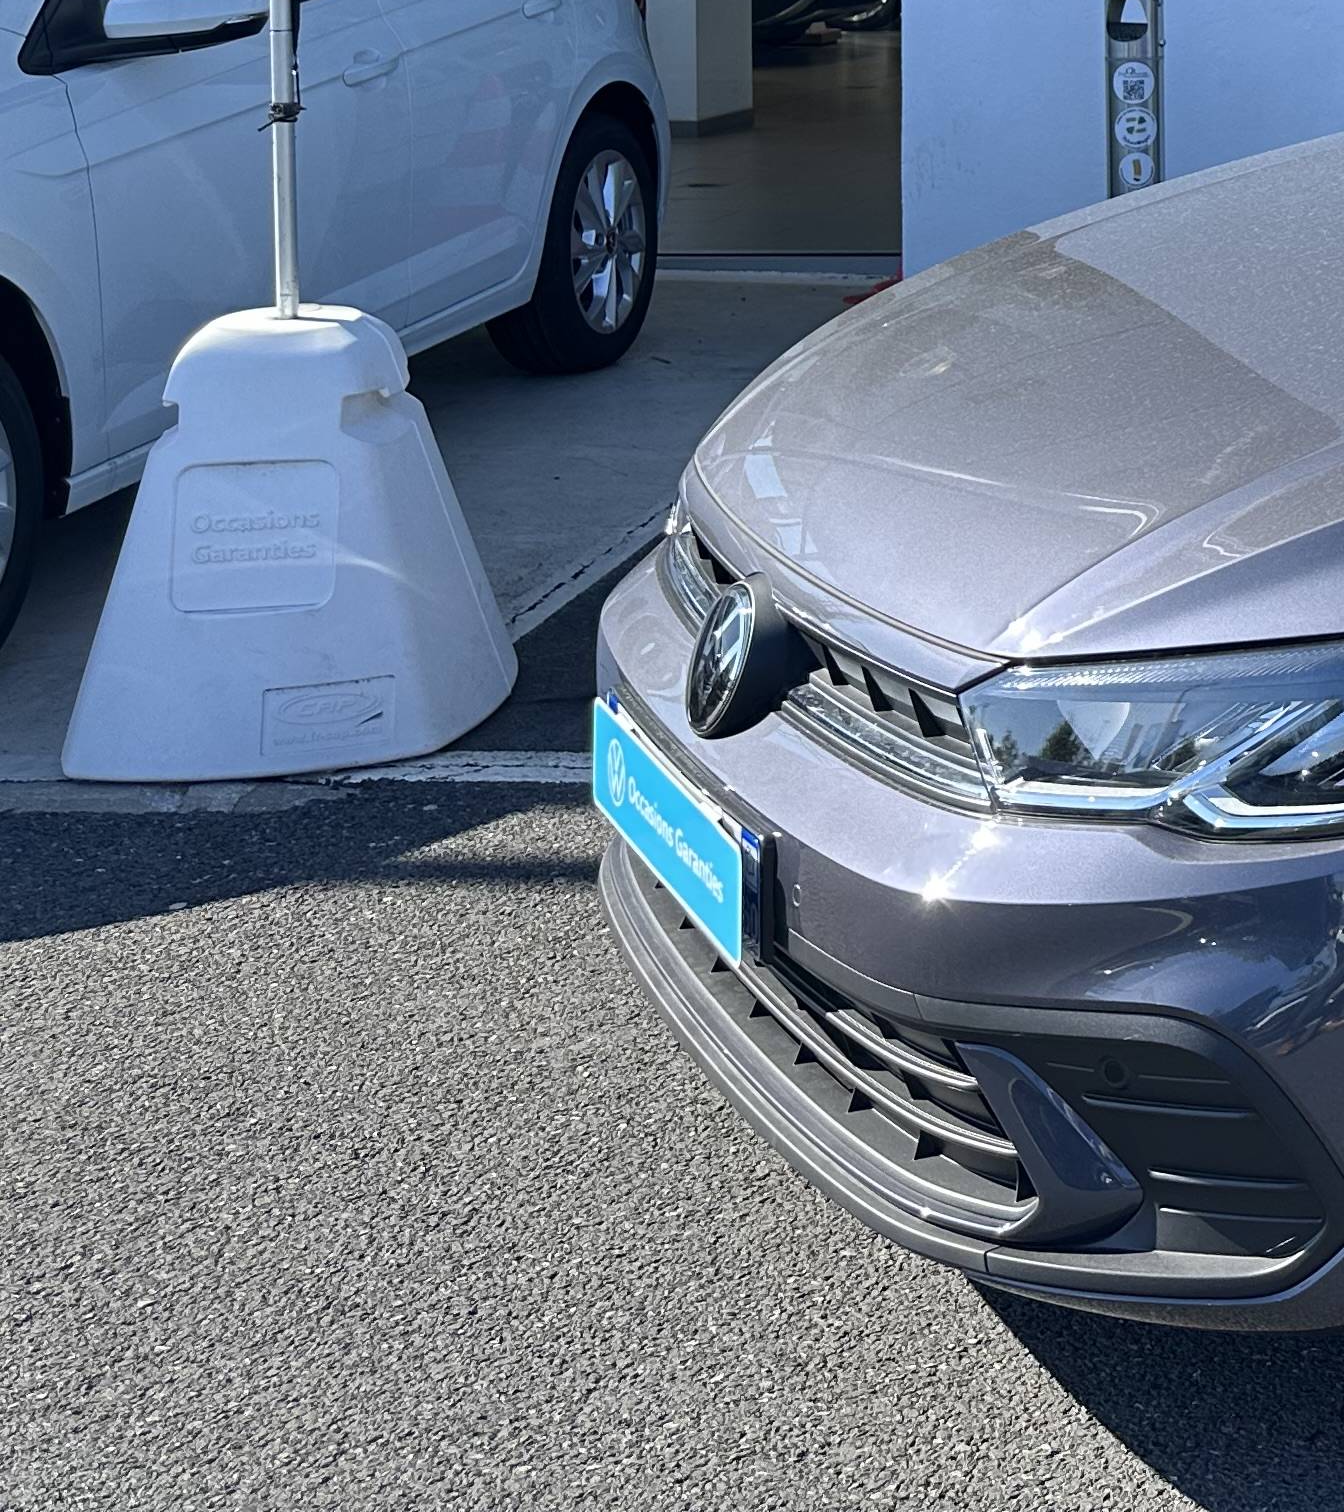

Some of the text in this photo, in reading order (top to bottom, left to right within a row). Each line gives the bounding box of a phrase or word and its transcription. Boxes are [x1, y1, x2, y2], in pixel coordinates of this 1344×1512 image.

[189, 508, 321, 535] Occasions
[190, 538, 318, 565] Garanties
[628, 775, 674, 849] Occasions
[675, 827, 724, 905] Garanties
